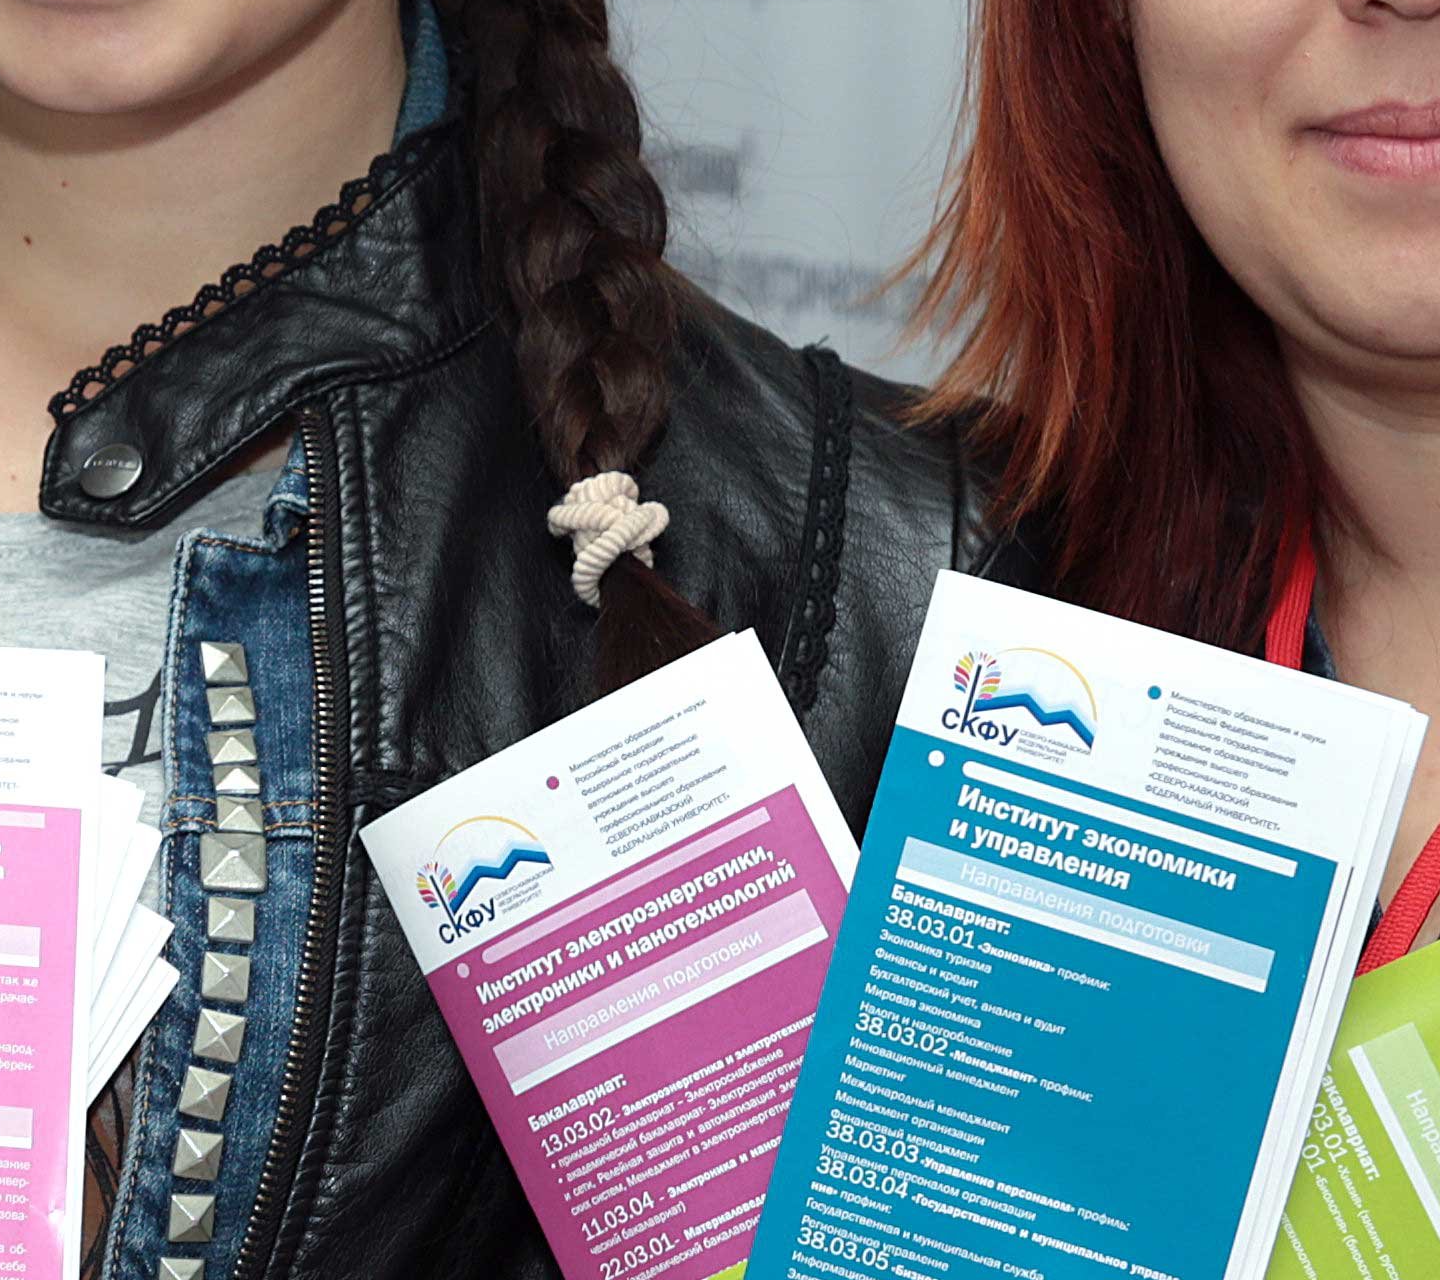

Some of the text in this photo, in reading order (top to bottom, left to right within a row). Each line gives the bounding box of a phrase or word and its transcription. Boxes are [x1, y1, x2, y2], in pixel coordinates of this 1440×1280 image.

[940, 707, 1019, 746] СКФУ
[948, 818, 1130, 890] и управления
[957, 783, 1237, 890] Институт экономики
[438, 896, 495, 944] СКФУ
[475, 845, 774, 1004] Институт электроэнергетики,
[884, 904, 974, 949] 38.03.01
[890, 883, 1011, 935] Бакалавриат:
[959, 862, 1211, 956] Направления подготовки
[481, 855, 795, 1034] электроники и нанотехнологий
[874, 946, 979, 988] Финансы и кредит
[878, 928, 992, 974] Экономика туризма
[542, 930, 762, 1050] Направления подготовки
[854, 1011, 951, 1056] 38.03.02
[844, 1053, 907, 1082] Маркетинг
[527, 1073, 627, 1132] Бакалавриат:
[1320, 1064, 1382, 1182] акалавриат:
[825, 1119, 919, 1163] 38.03.03
[815, 1154, 909, 1198] 38.03.04
[581, 1190, 654, 1241] 11.03.04
[796, 1226, 893, 1270] 38.03.05
